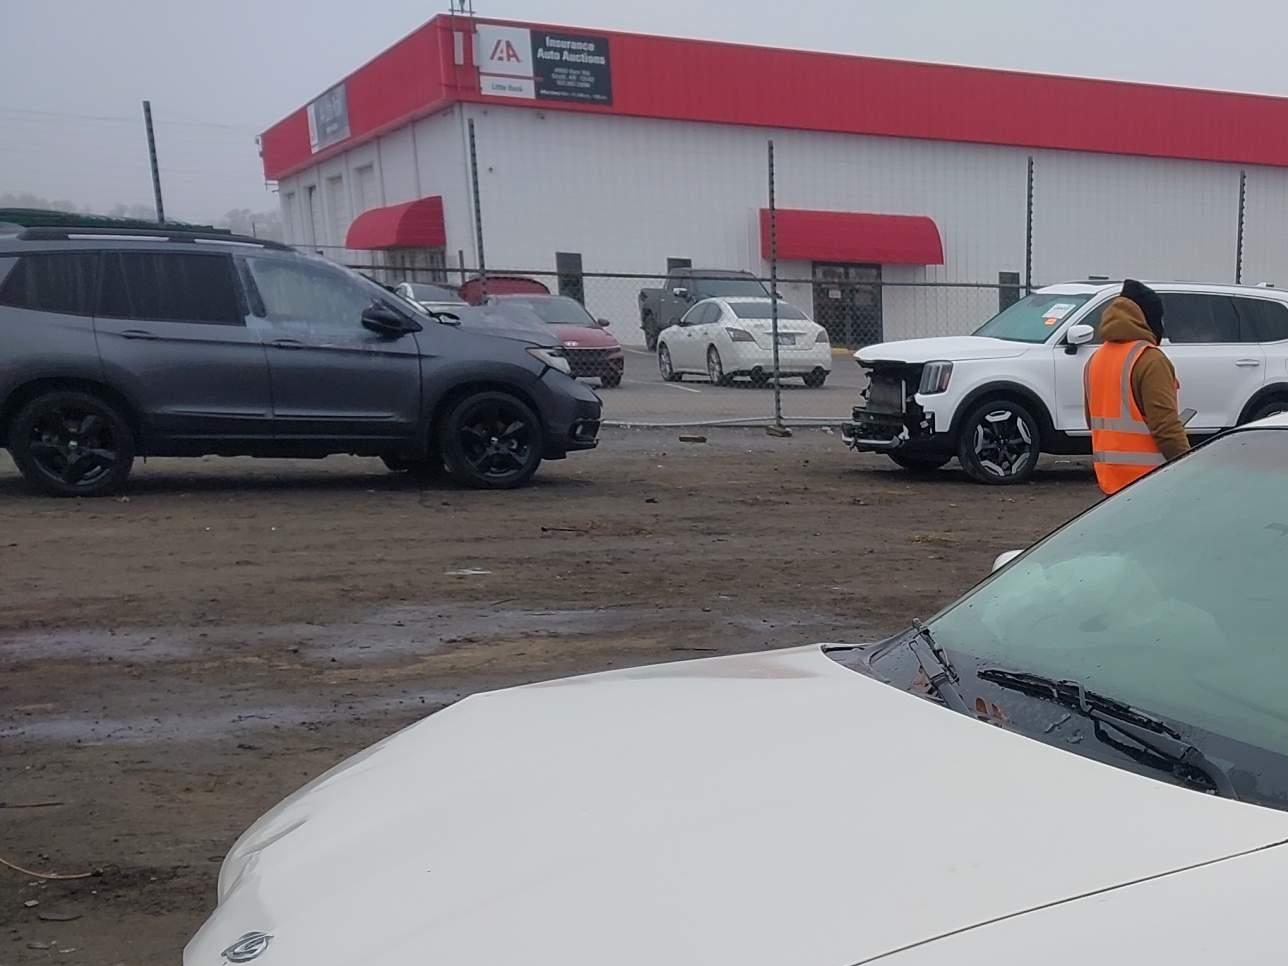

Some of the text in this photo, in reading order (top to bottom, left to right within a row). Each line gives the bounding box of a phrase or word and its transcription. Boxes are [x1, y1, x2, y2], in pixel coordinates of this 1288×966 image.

[545, 36, 595, 51] Insurance
[537, 48, 606, 65] Auto Auctions
